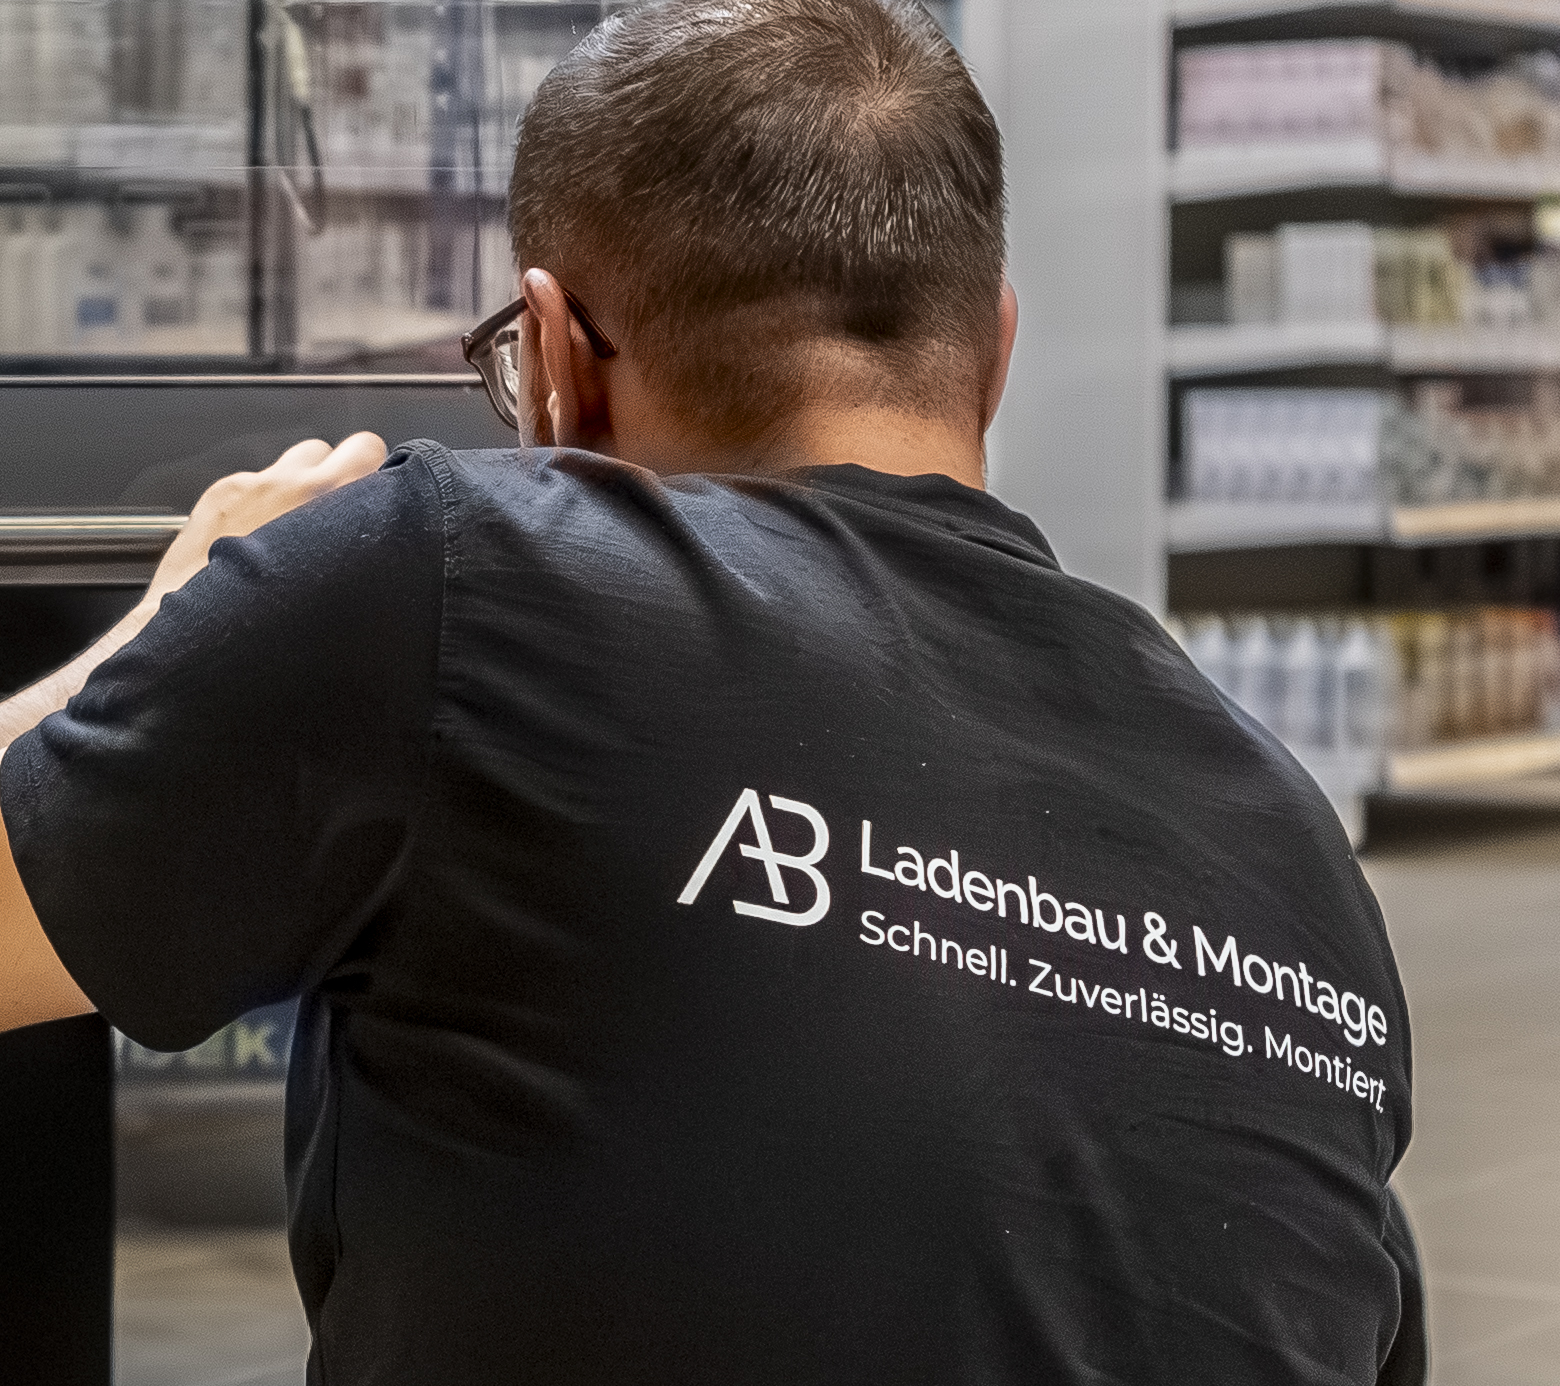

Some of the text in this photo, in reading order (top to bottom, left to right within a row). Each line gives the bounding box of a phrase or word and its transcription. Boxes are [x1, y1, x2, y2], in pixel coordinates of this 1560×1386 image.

[858, 910, 1017, 987] Schnell.
[1027, 958, 1254, 1057] Zuverlässig.
[859, 819, 1389, 1048] Ladenbau & Montage
